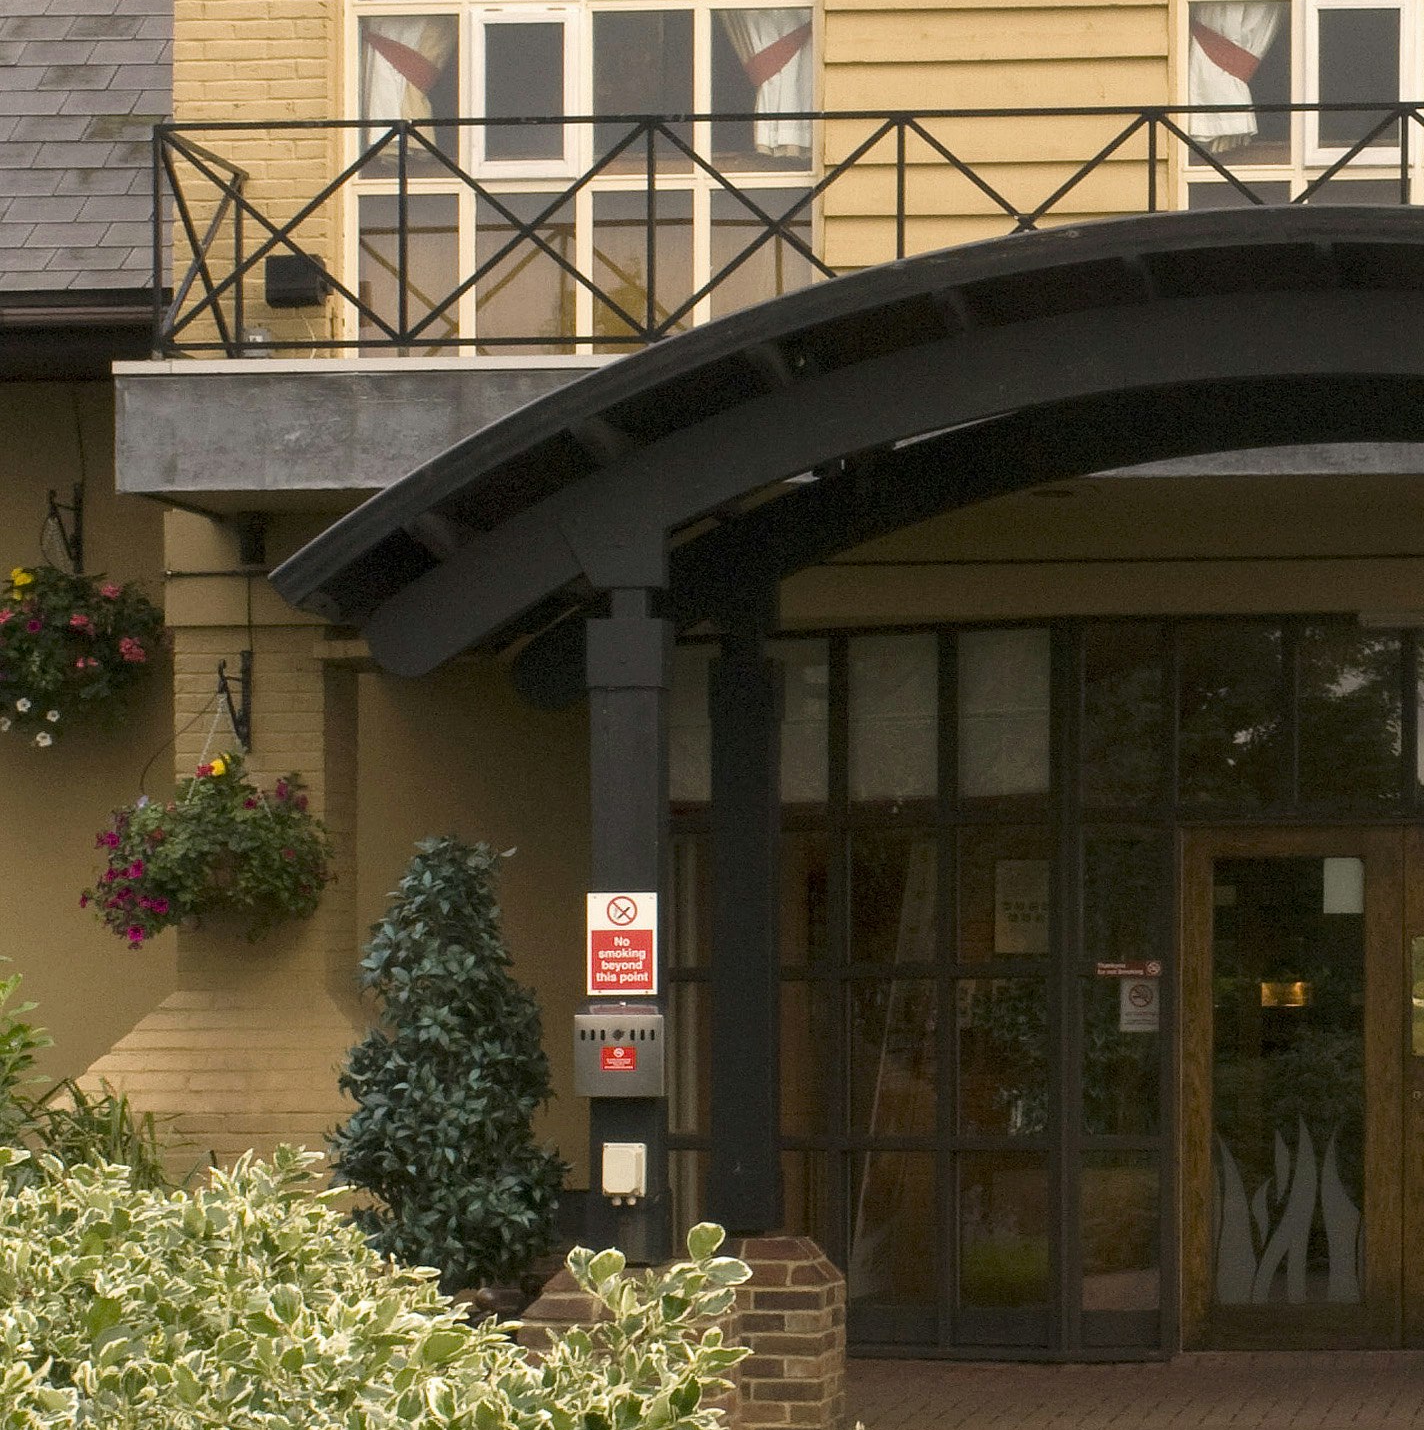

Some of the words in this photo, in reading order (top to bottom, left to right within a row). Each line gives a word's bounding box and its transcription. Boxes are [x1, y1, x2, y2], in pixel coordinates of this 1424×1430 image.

[614, 936, 630, 947] No
[599, 949, 646, 960] smoking
[602, 961, 643, 971] beyond
[596, 973, 617, 983] this
[620, 973, 650, 984] point
